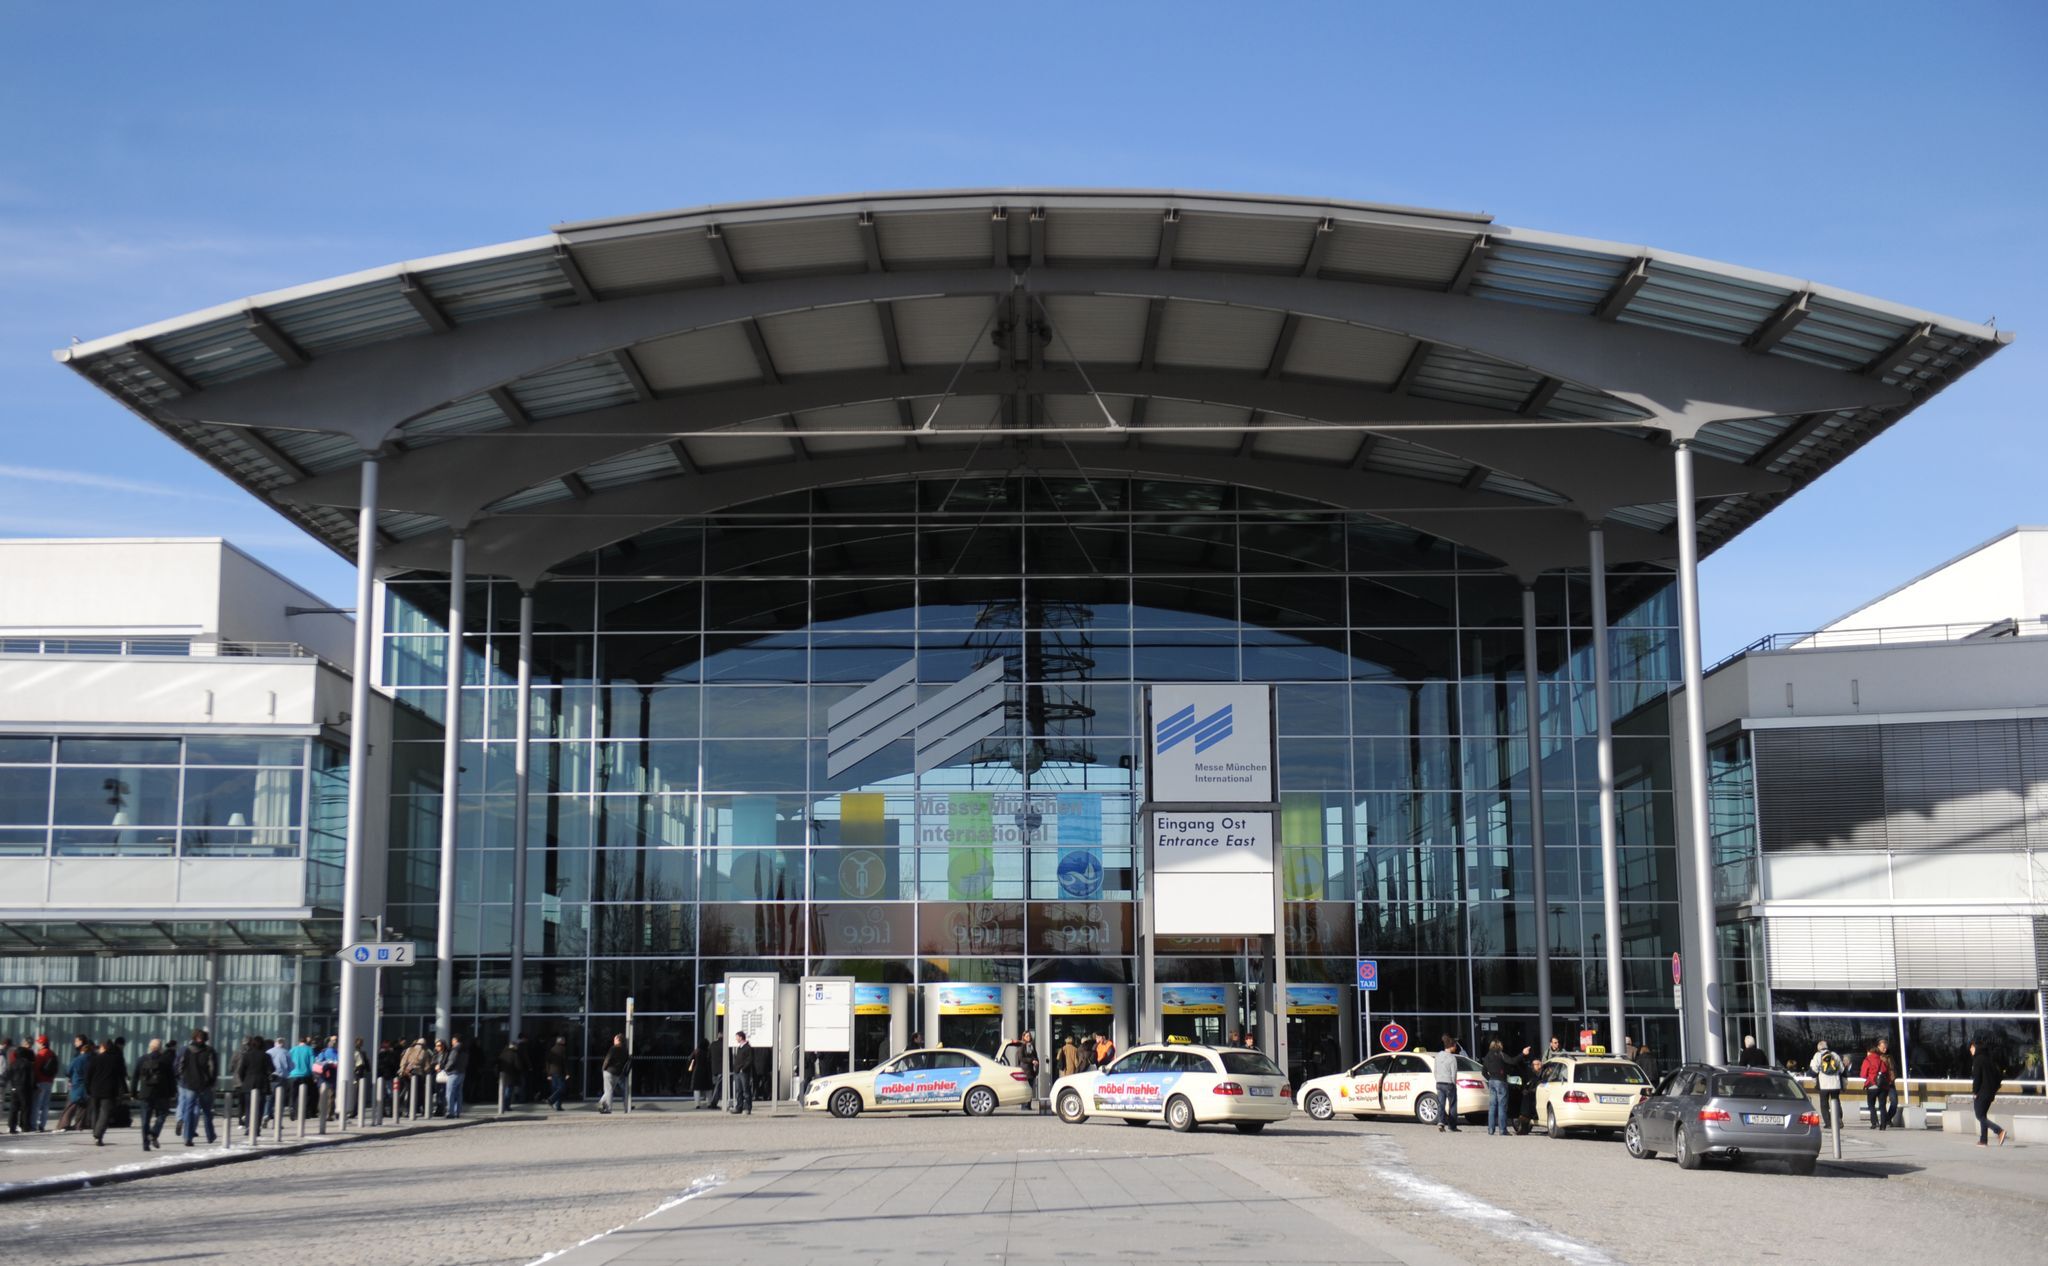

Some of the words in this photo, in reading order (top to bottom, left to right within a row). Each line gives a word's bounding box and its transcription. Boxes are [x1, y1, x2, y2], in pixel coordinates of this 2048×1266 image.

[1195, 763, 1224, 771] Messe
[1226, 762, 1267, 771] München
[1195, 775, 1253, 783] International
[1158, 817, 1215, 833] Eingang
[1221, 817, 1246, 829] Ost
[1159, 835, 1219, 847] Entrance
[1226, 835, 1256, 847] East
[395, 946, 405, 962] 2
[1360, 980, 1376, 988] TAXI
[881, 1082, 914, 1094] möbel
[1098, 1083, 1125, 1094] möbel
[1355, 1081, 1411, 1094] SEGMÜLLER
